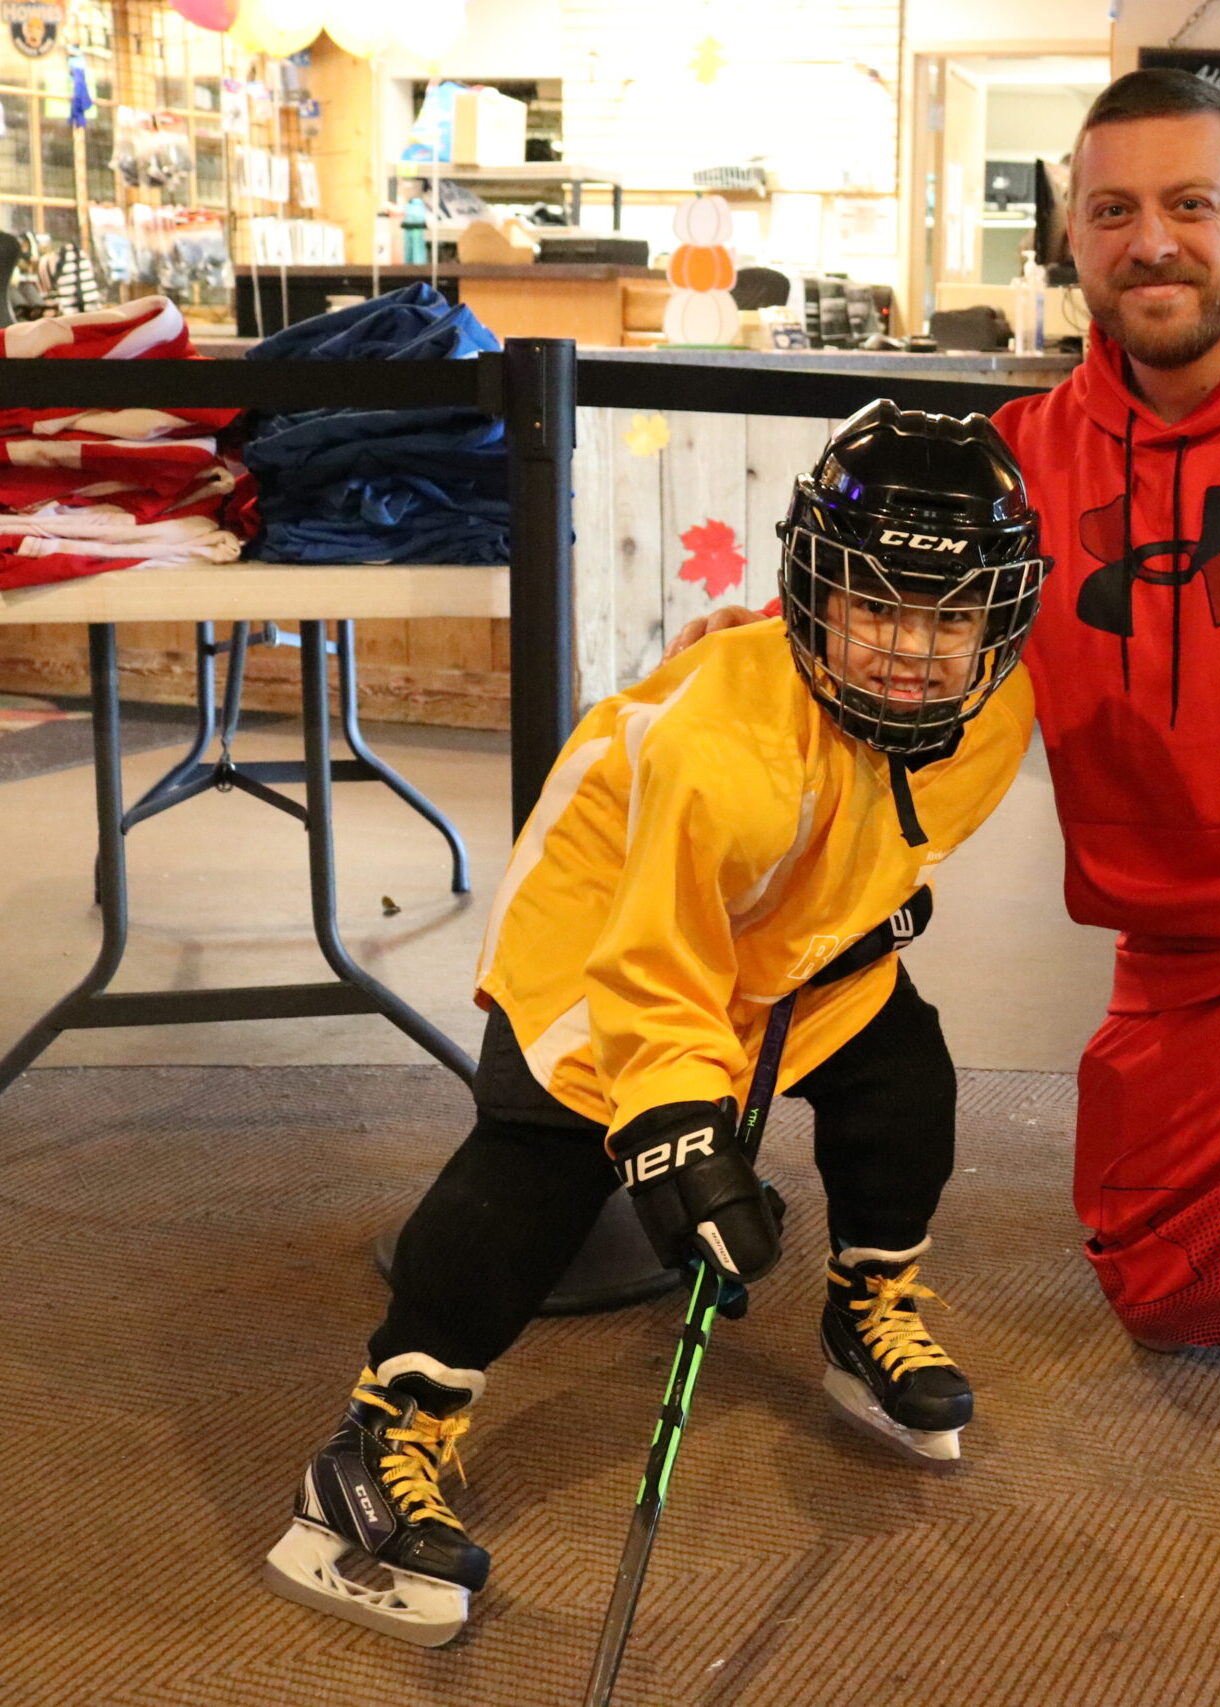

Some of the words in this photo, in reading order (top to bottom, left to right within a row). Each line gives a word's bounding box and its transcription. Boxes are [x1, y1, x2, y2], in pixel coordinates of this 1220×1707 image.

[879, 529, 968, 554] CCM
[746, 1108, 759, 1128] YTH
[355, 1484, 379, 1523] CCM
